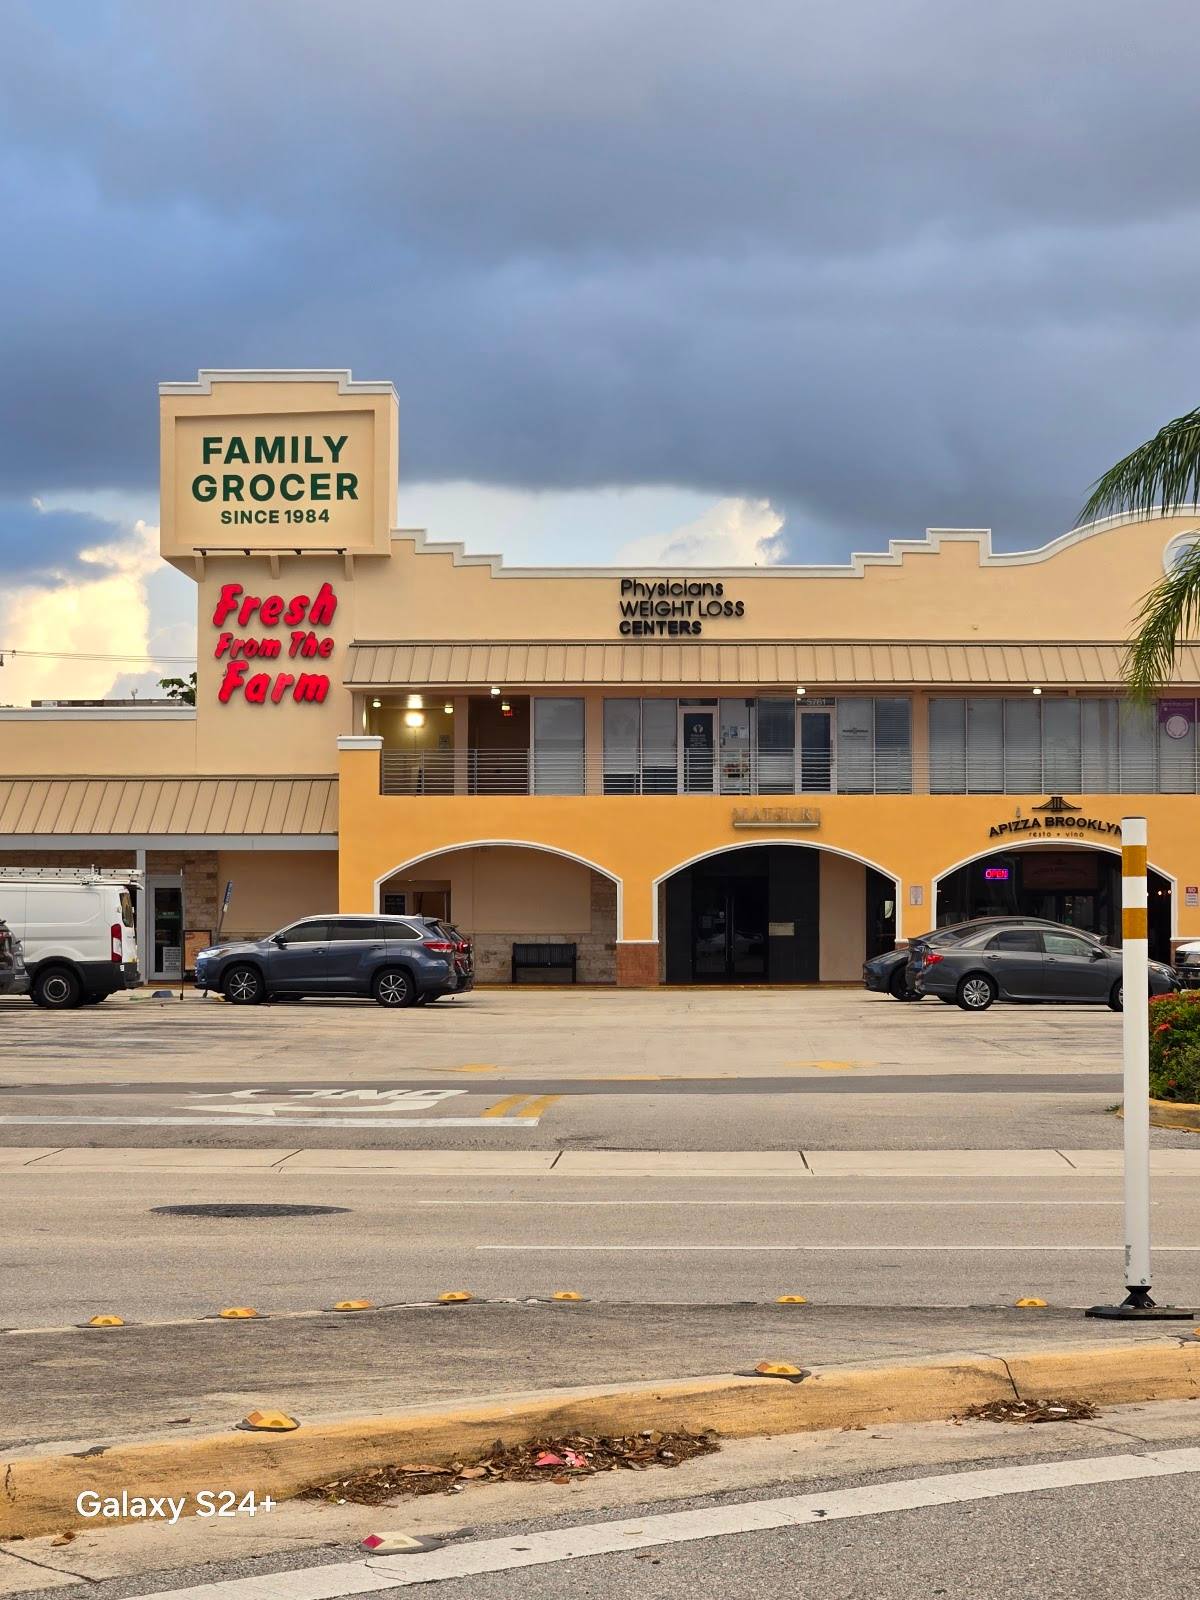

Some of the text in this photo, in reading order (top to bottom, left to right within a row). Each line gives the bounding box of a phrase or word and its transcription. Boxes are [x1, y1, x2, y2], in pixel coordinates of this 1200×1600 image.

[202, 436, 349, 464] FAMILY
[191, 473, 359, 502] GROCER
[221, 509, 330, 524] SINCE 1984
[620, 579, 724, 600] Physicians
[212, 582, 338, 627] Fresh
[620, 601, 745, 617] WEIGHT LOSS
[619, 620, 702, 635] CENTERS
[214, 631, 335, 659] From The
[218, 660, 330, 704] Farm
[989, 816, 1122, 838] APIZZA BROOKLYN
[1028, 830, 1052, 838] resto
[985, 869, 1009, 879] OPEN
